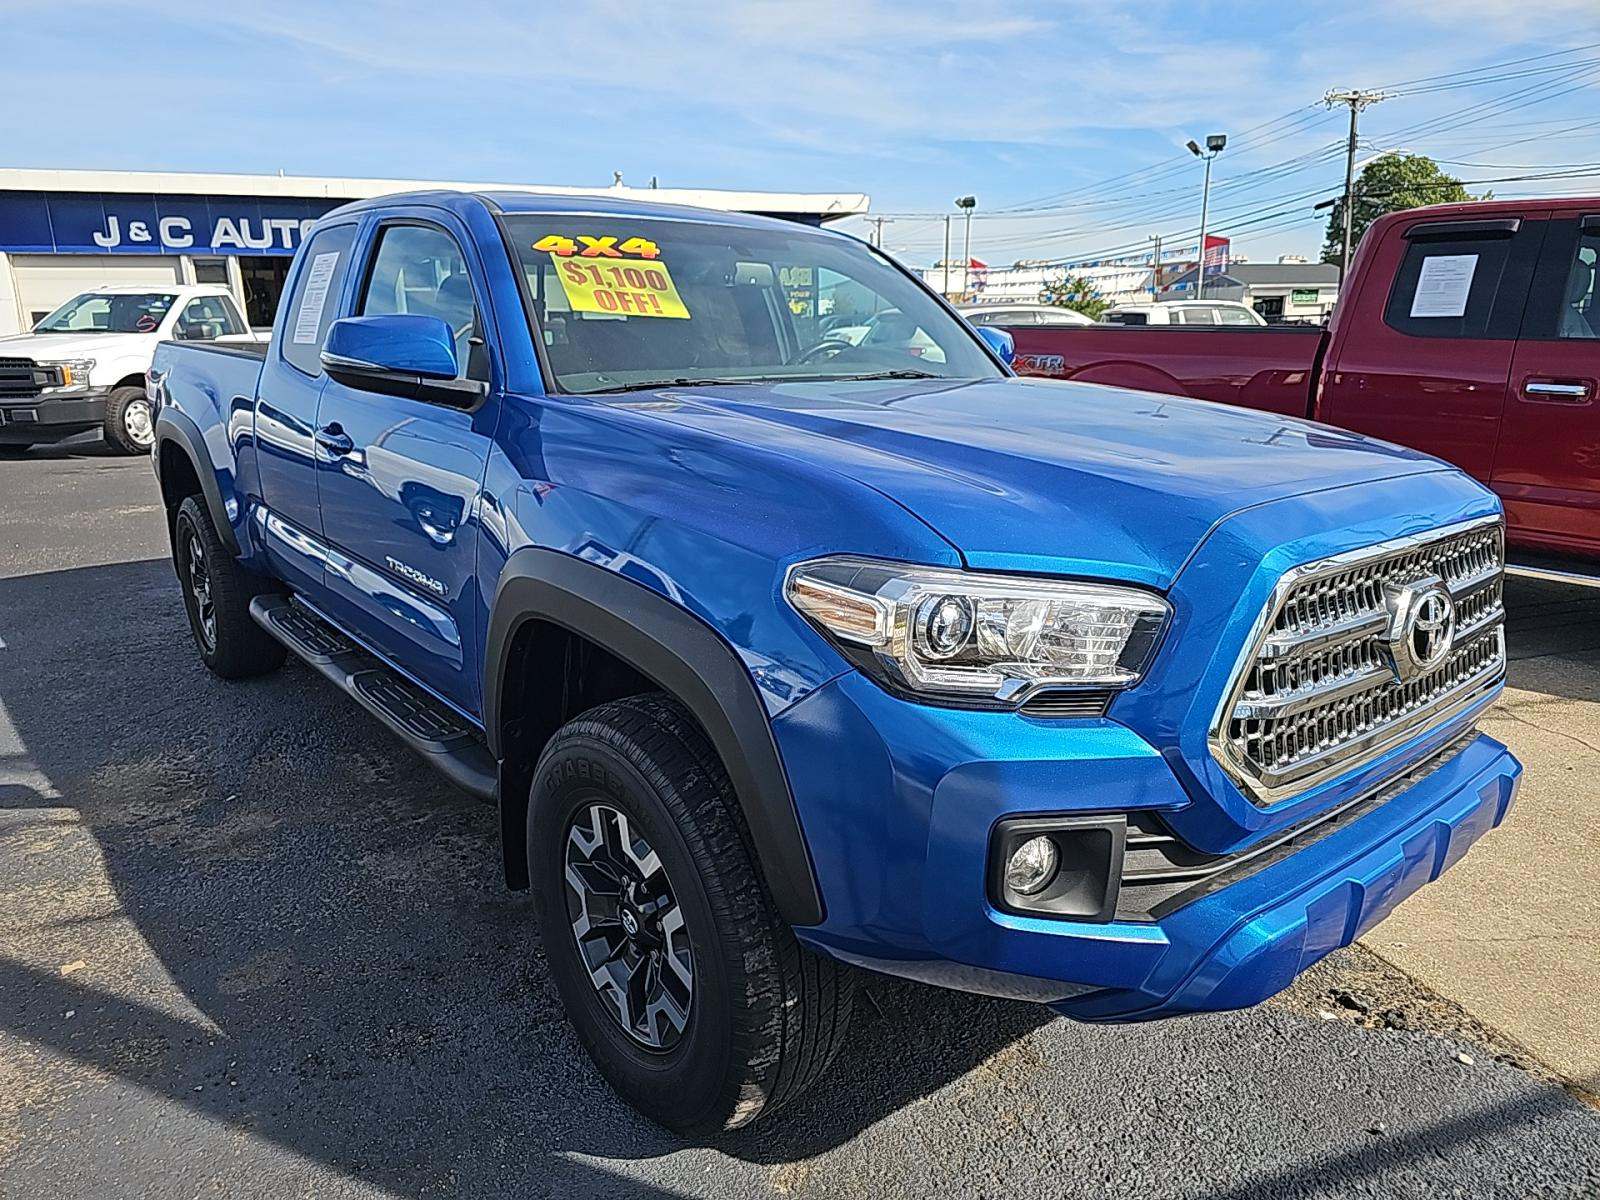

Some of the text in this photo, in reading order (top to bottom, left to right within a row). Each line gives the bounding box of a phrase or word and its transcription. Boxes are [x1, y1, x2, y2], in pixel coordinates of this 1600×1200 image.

[93, 216, 121, 247] J
[128, 221, 152, 242] &
[160, 216, 194, 248] C
[531, 235, 661, 259] 4X4
[562, 260, 668, 292] $1,100
[593, 289, 664, 314] OFF!
[1010, 354, 1065, 373] XTR
[385, 554, 449, 596] TACOMA
